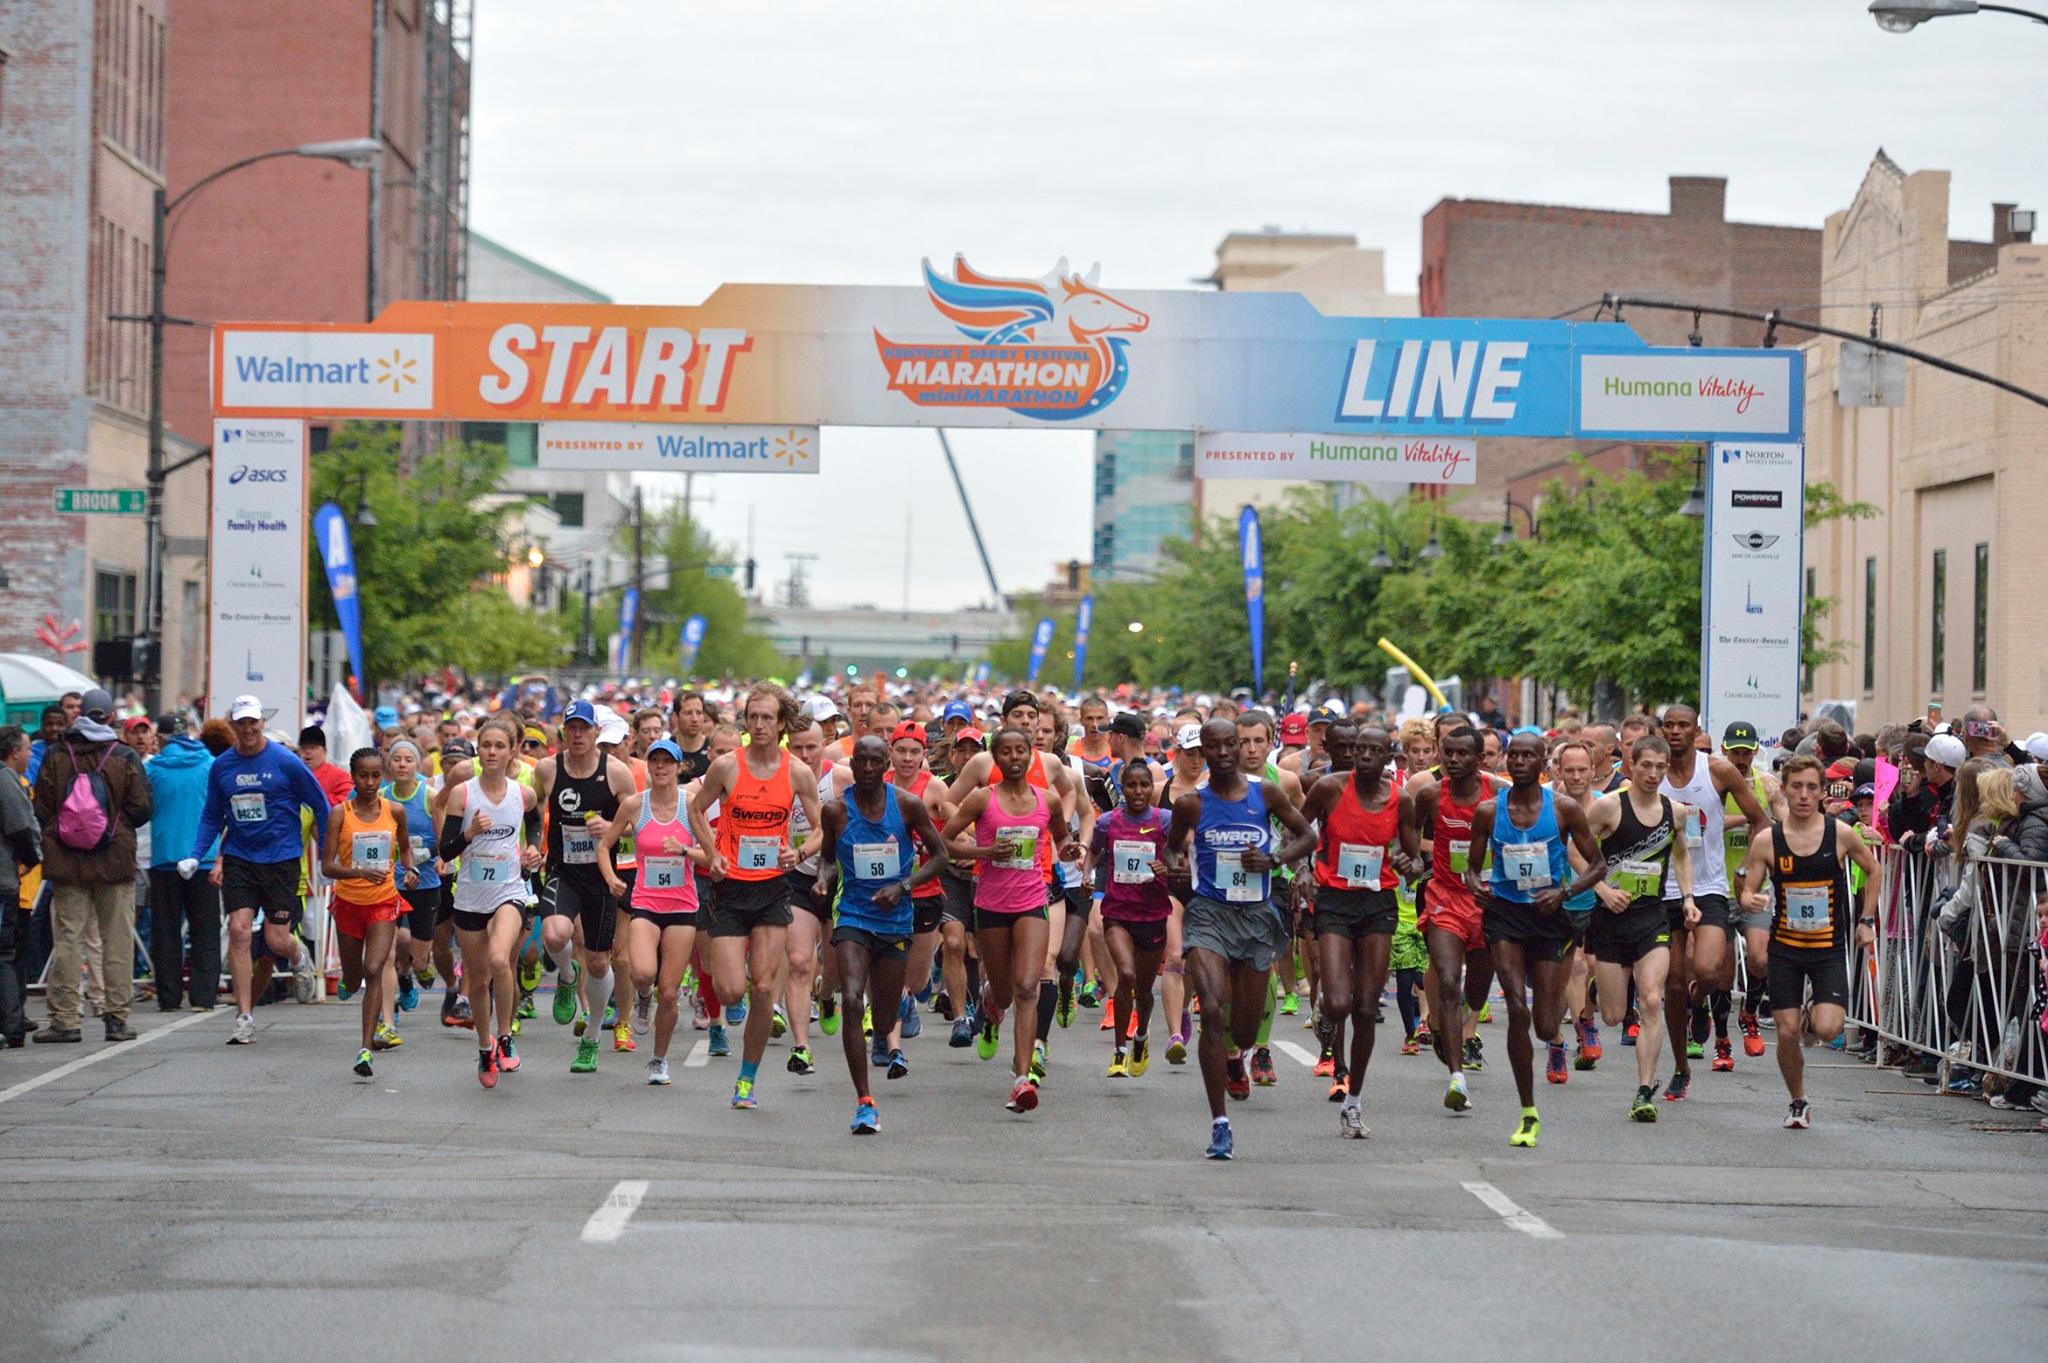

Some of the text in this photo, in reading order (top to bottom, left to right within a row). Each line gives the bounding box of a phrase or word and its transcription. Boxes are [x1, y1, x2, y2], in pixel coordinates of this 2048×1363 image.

[884, 347, 1091, 362] KENTUCKY DERBY FESTIVAL
[235, 356, 369, 384] Walmart
[479, 324, 751, 409] START
[895, 361, 1089, 387] MARATHON
[1338, 339, 1529, 421] LINE
[918, 387, 1079, 404] miniMARATHON
[1604, 375, 1764, 414] Humana Vitality
[245, 430, 285, 438] NORTON
[546, 440, 645, 451] PRESENTED BY
[656, 435, 769, 459] Walmart
[1206, 451, 1295, 461] PRESENTED BY
[1309, 440, 1470, 480] Humana Vitality
[1745, 450, 1785, 459] NORTON
[248, 470, 287, 482] asics
[72, 491, 119, 511] BROOK
[1734, 494, 1778, 502] POWERADE
[227, 520, 287, 533] Family Health
[1719, 636, 1731, 644] The
[1188, 729, 1200, 737] RU
[731, 806, 783, 823] Swags
[484, 827, 510, 836] wags
[1205, 829, 1261, 845] Swags
[570, 841, 594, 852] 308A
[1607, 821, 1670, 865] SKECHERS
[753, 854, 766, 867] 55
[1127, 858, 1140, 871] 67
[483, 868, 495, 881] 72
[871, 862, 885, 876] 58
[1354, 864, 1367, 878] 61
[1519, 863, 1533, 877] 57
[659, 873, 671, 885] 54
[1232, 872, 1247, 886] 84
[1636, 879, 1648, 893] 13
